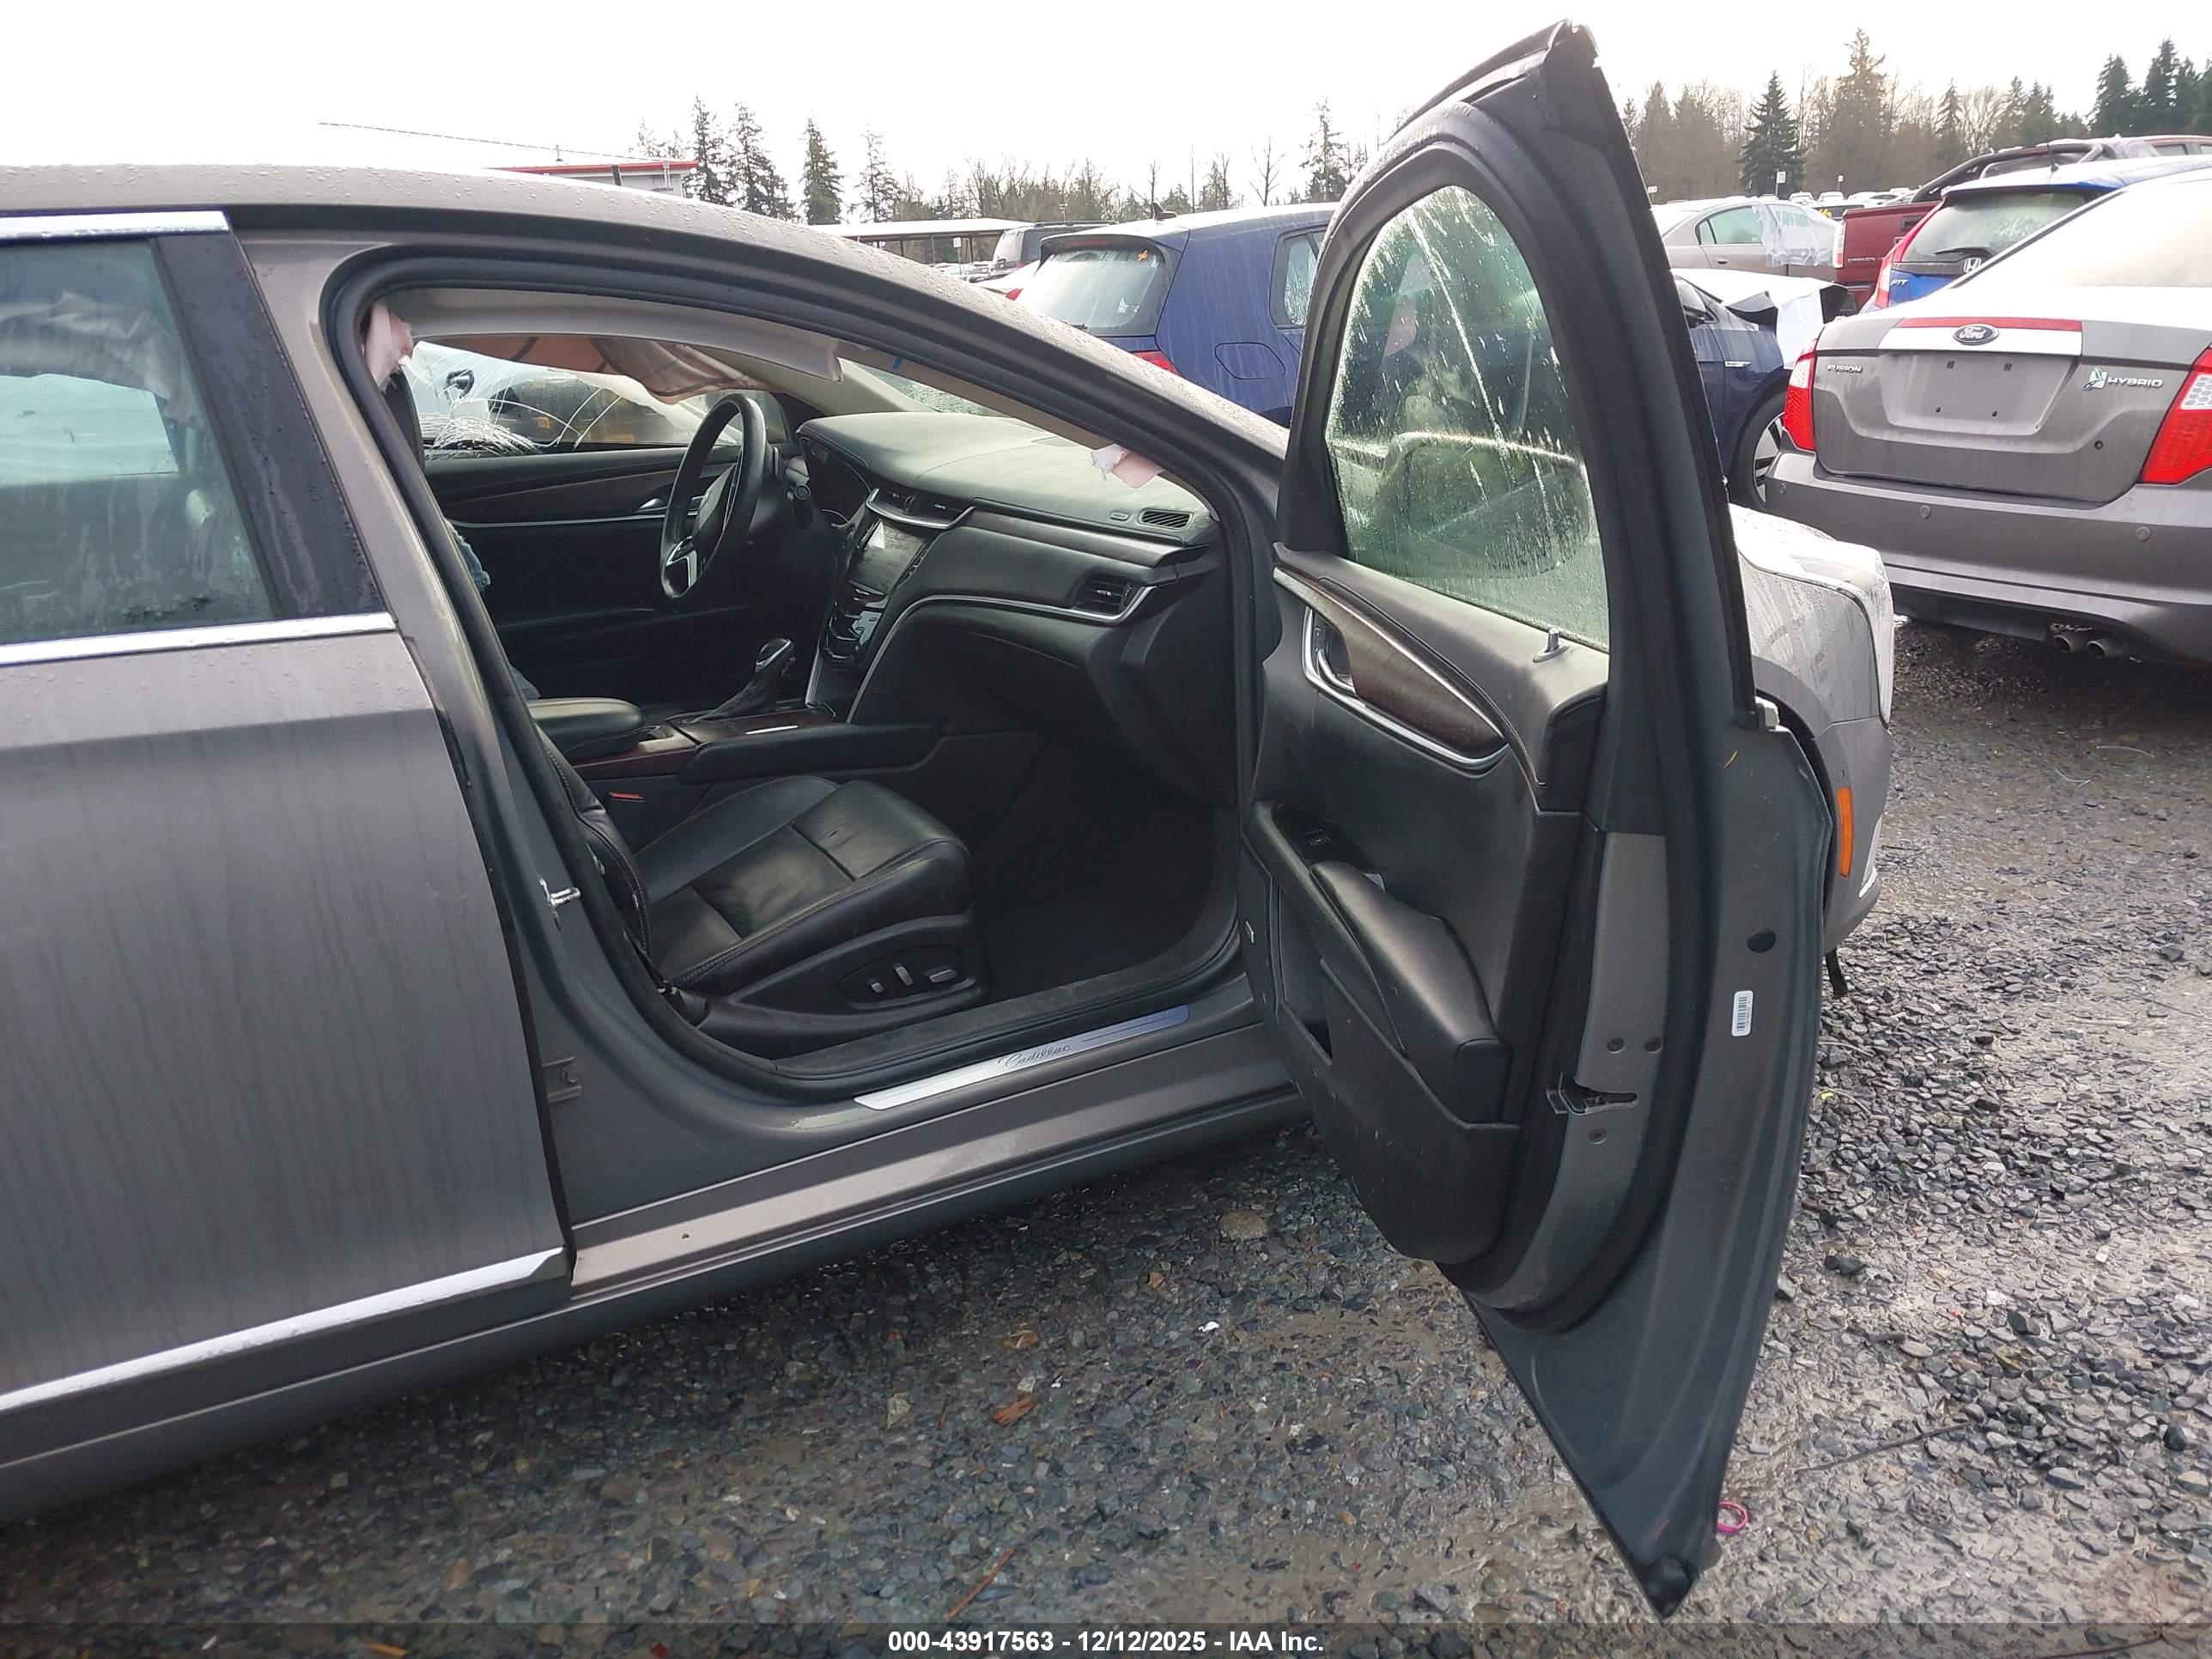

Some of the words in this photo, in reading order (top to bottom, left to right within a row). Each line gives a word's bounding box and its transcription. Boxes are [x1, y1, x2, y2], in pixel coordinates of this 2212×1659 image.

[1959, 327, 1986, 340] Ford
[1827, 364, 1863, 374] FUSION
[2107, 377, 2164, 388] HYBRID
[998, 1045, 1072, 1067] Cadillac
